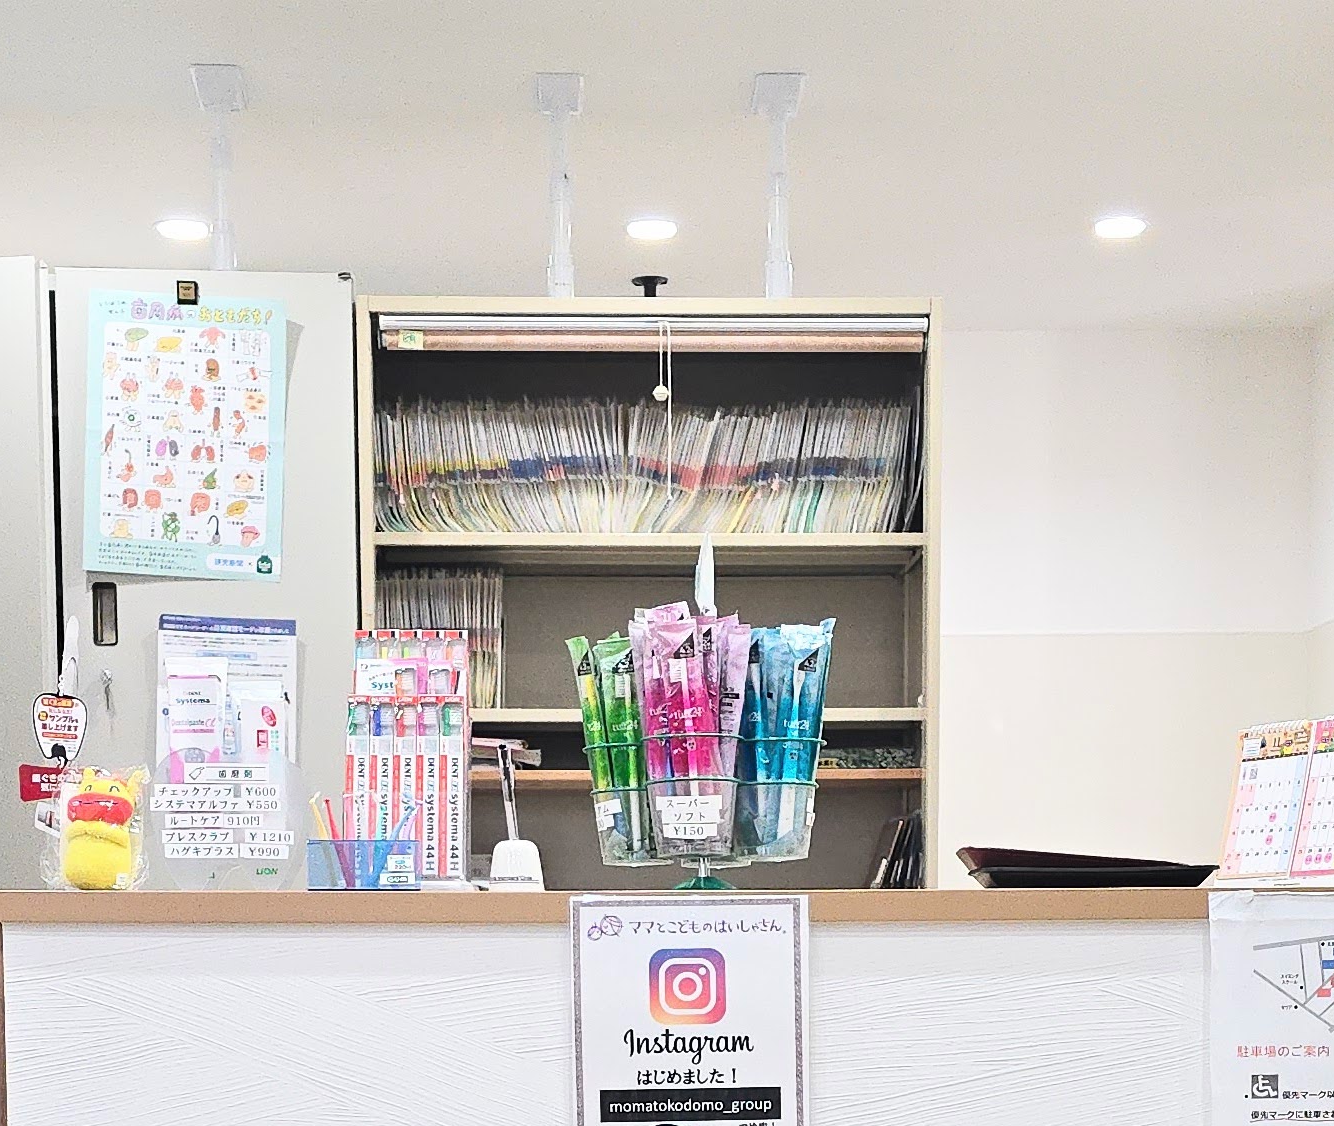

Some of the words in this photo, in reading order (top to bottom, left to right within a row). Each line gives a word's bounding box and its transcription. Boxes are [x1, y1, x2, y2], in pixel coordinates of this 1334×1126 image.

[667, 799, 709, 808] スーパー
[675, 812, 705, 821] ソフト
[623, 1029, 755, 1065] Instagram
[1237, 1045, 1330, 1058] 駐車場のご案内
[609, 1098, 772, 1113] momatokodomo_group
